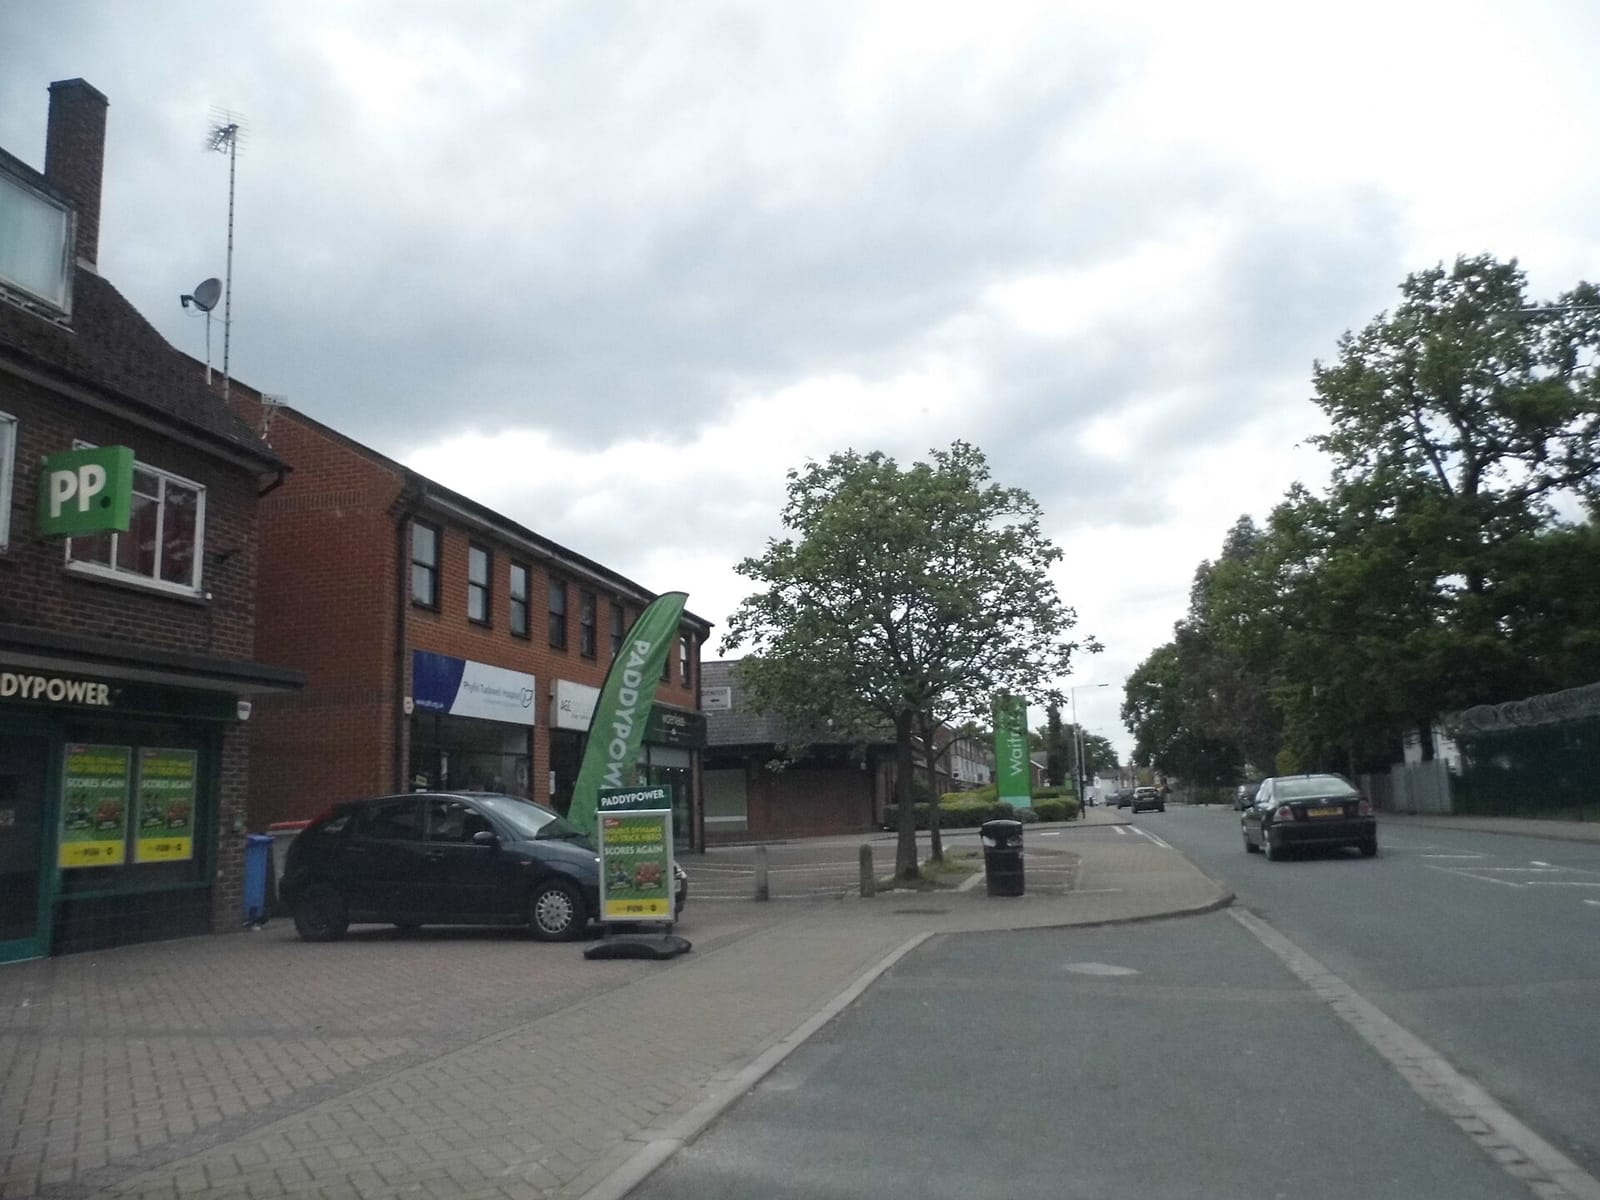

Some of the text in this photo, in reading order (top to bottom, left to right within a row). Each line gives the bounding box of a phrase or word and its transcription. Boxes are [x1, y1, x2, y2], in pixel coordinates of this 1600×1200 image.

[51, 464, 107, 518] PP
[0, 672, 110, 706] DYPOWER
[601, 640, 650, 788] PADDYPOW
[1007, 704, 1025, 776] Waitr
[601, 789, 665, 807] PADDYPOWER
[604, 845, 663, 856] SCORES AGAIN
